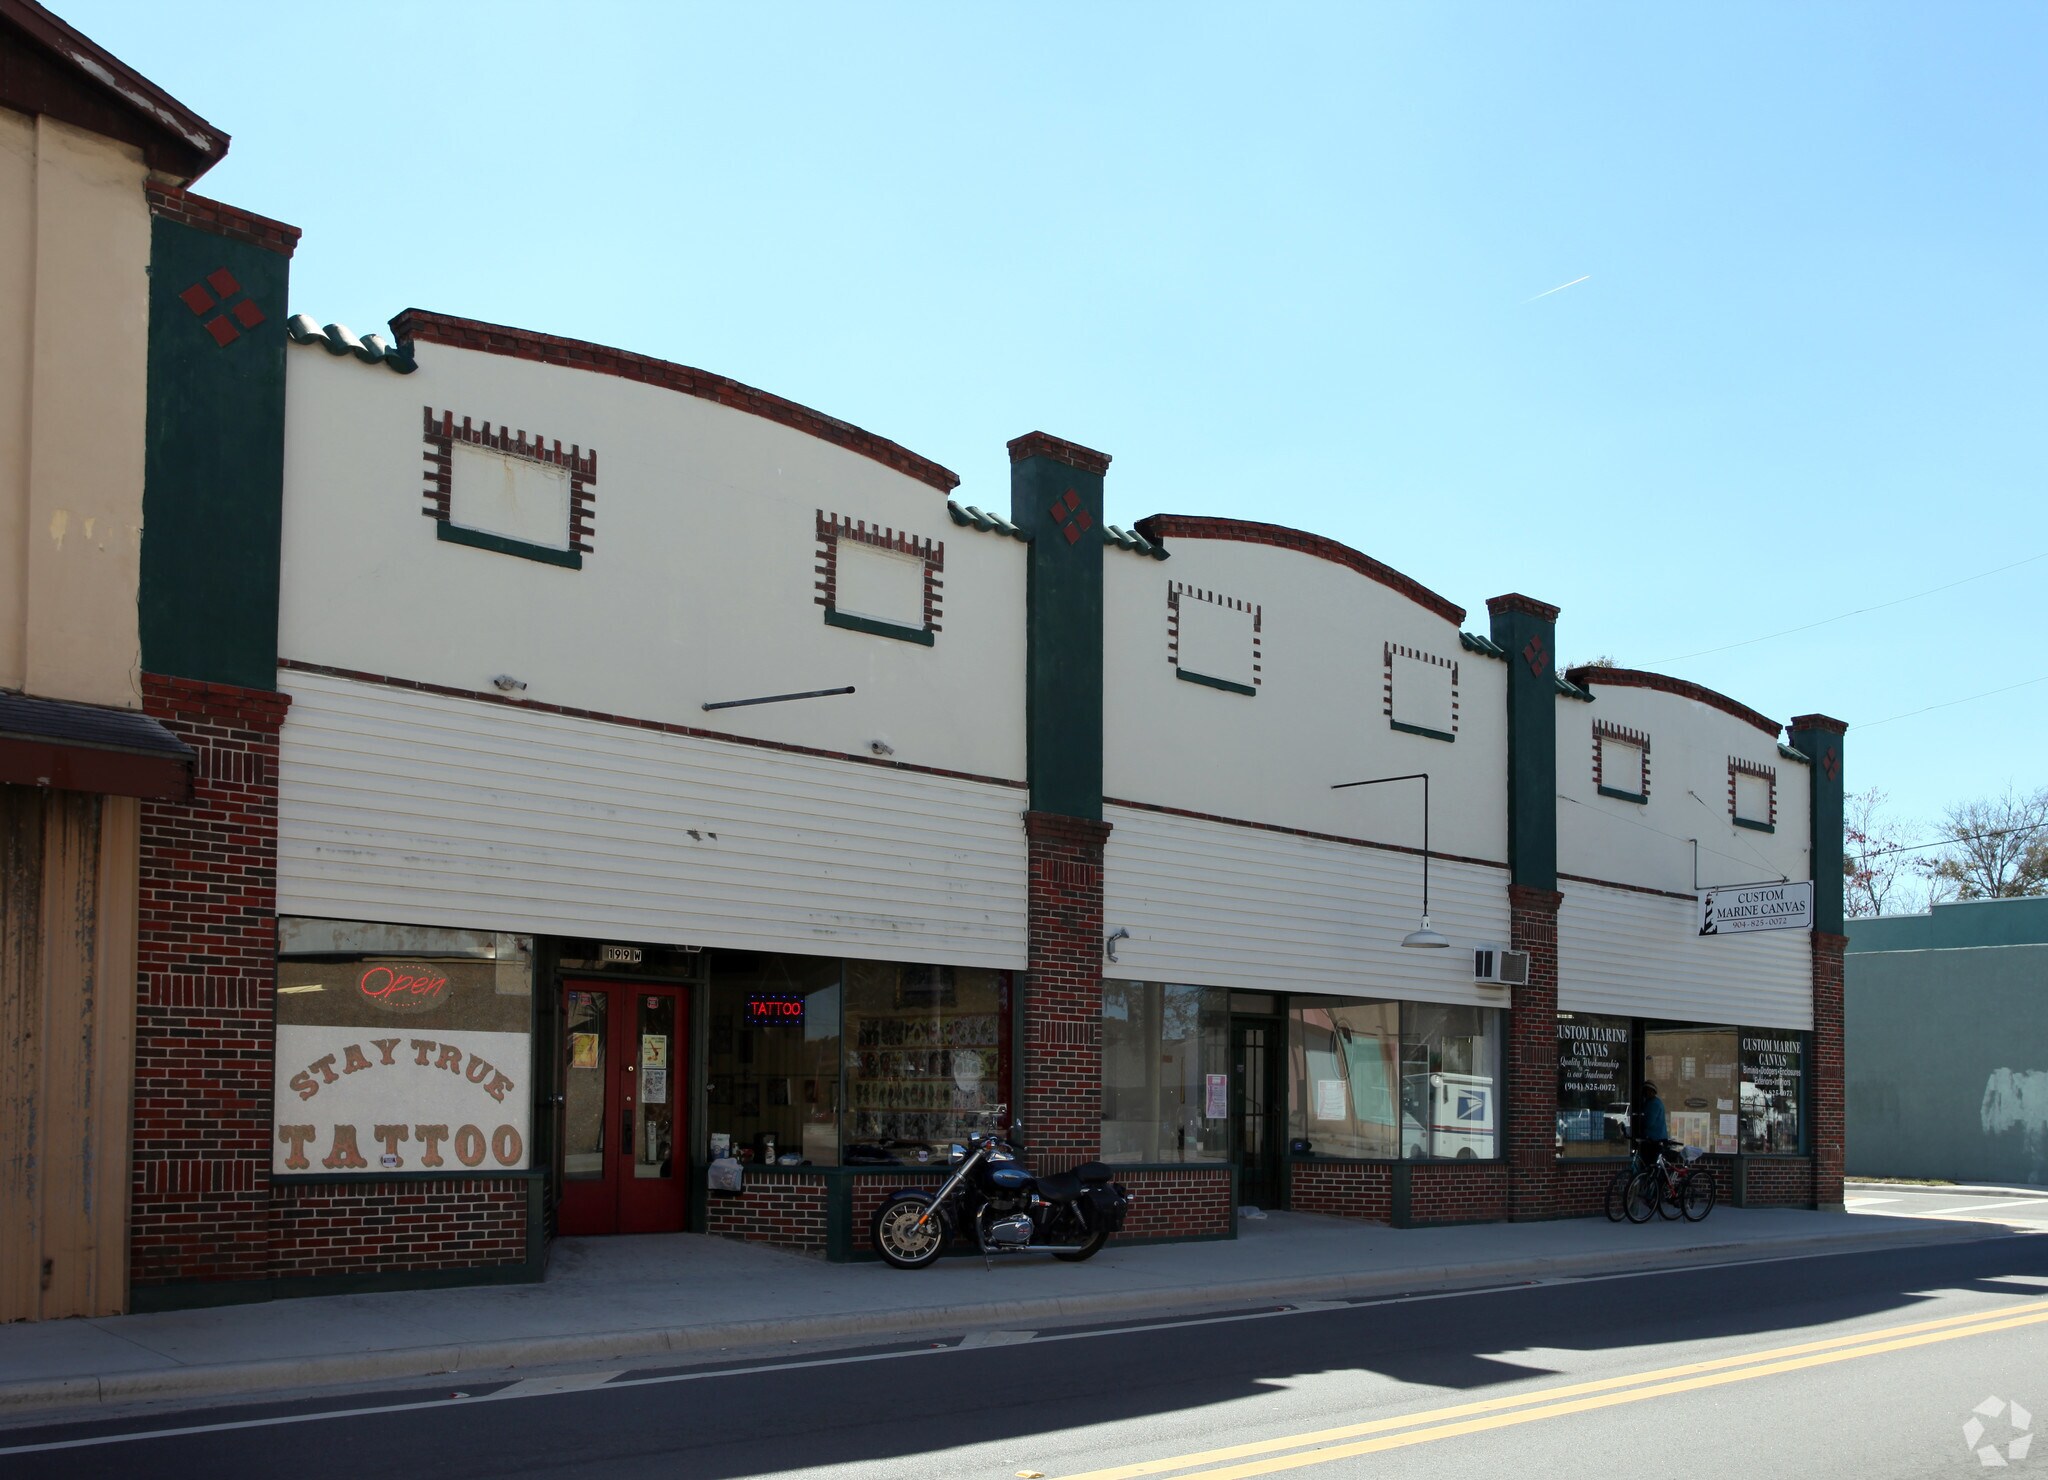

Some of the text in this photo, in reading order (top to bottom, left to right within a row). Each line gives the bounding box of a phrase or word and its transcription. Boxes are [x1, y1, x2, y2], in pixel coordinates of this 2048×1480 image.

[1738, 889, 1784, 904] CUSTOM
[1717, 900, 1806, 919] MARINE CANVAS
[609, 948, 641, 961] 199 W
[360, 966, 446, 998] Open
[750, 1001, 801, 1017] TATTOO
[1592, 1027, 1627, 1043] MARINE
[1573, 1041, 1608, 1057] CANVAS
[1743, 1038, 1801, 1054] CUSTOM MARINE
[1560, 1056, 1620, 1070] Quality Workmanship
[1758, 1053, 1787, 1067] CANVAS
[289, 1037, 402, 1102] STAY
[410, 1038, 515, 1104] TRUE
[1583, 1069, 1614, 1080] Trademark
[1564, 1083, 1616, 1092] (904) 825-0072
[277, 1124, 524, 1170] TATTOO
